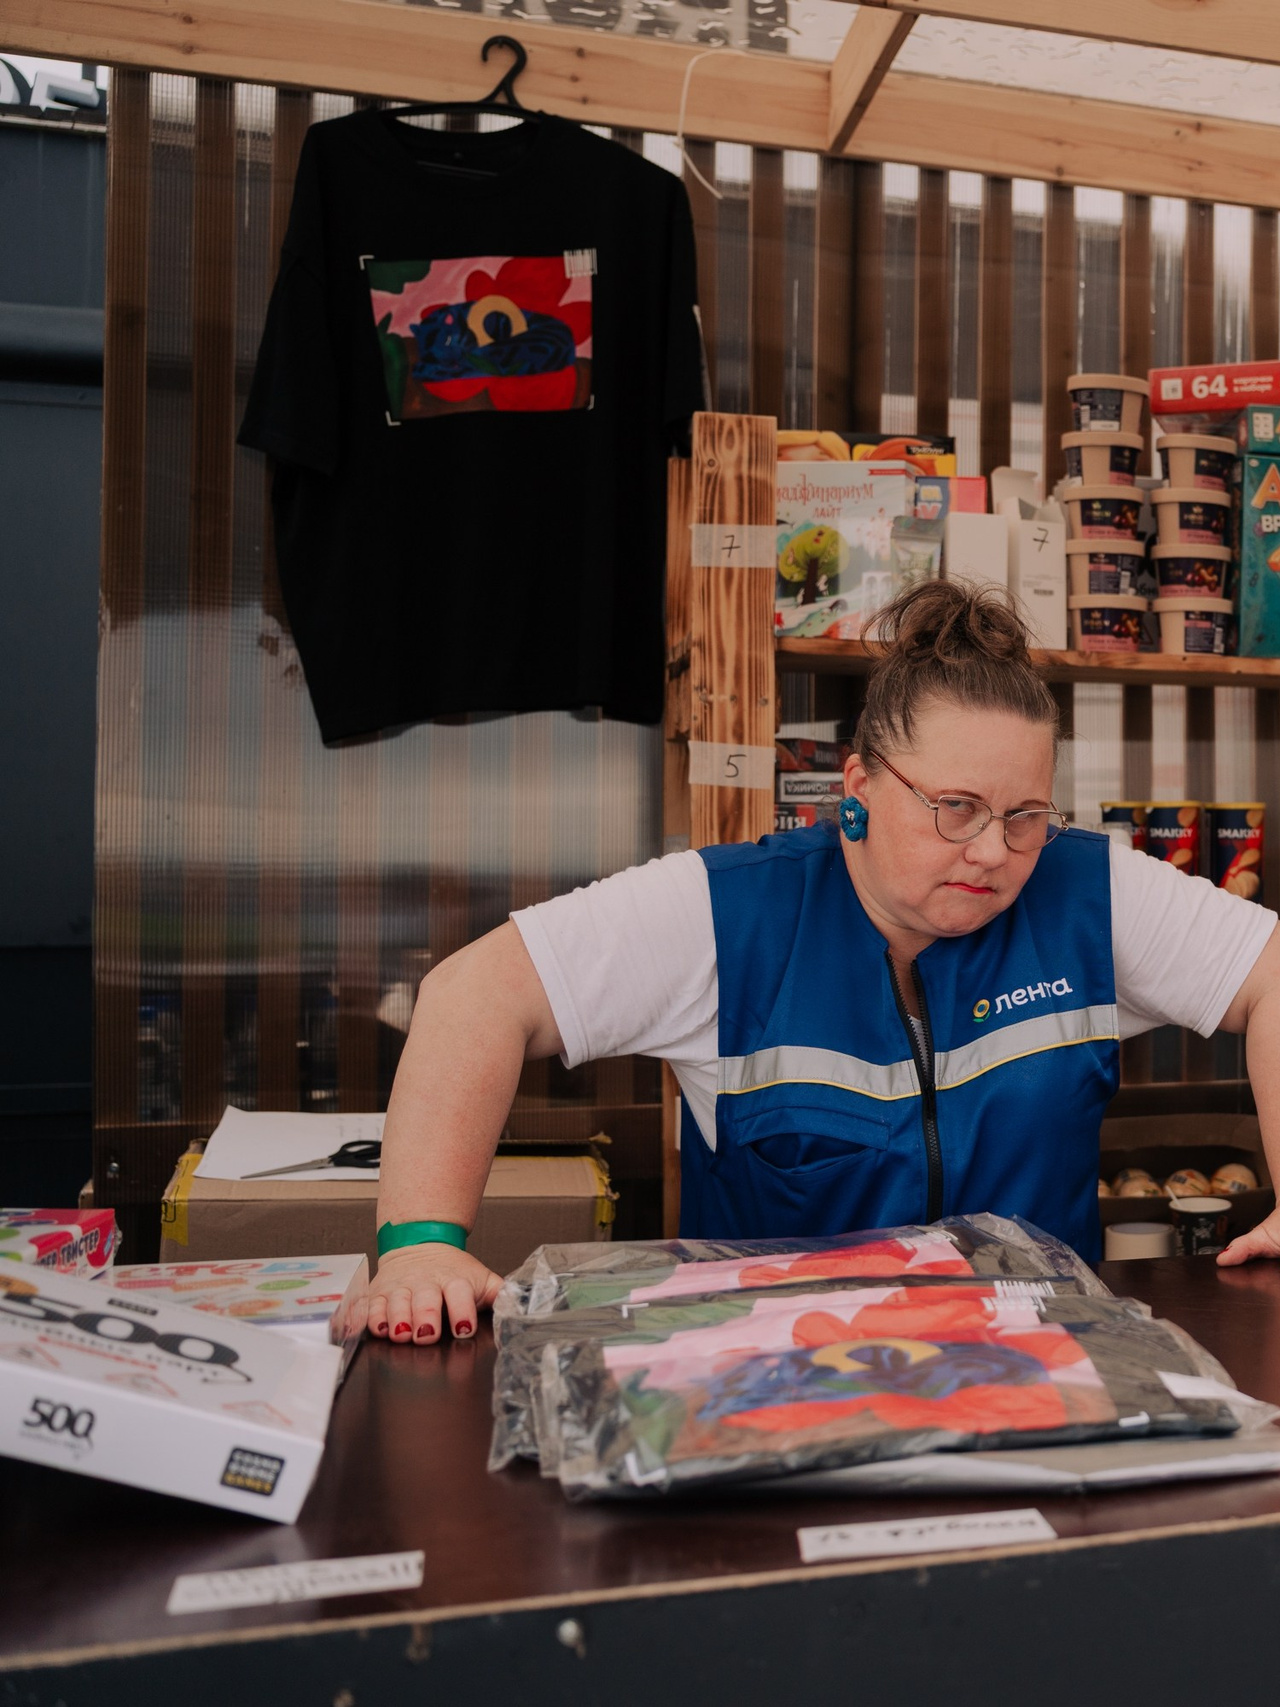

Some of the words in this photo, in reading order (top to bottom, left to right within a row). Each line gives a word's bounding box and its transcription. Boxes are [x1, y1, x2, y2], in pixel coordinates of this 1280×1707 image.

[1191, 375, 1228, 399] 64
[721, 534, 742, 558] 7
[1032, 526, 1050, 552] 7
[724, 754, 748, 779] 5
[995, 977, 1073, 1014] лента
[60, 1227, 100, 1266] ТВИСТЕР
